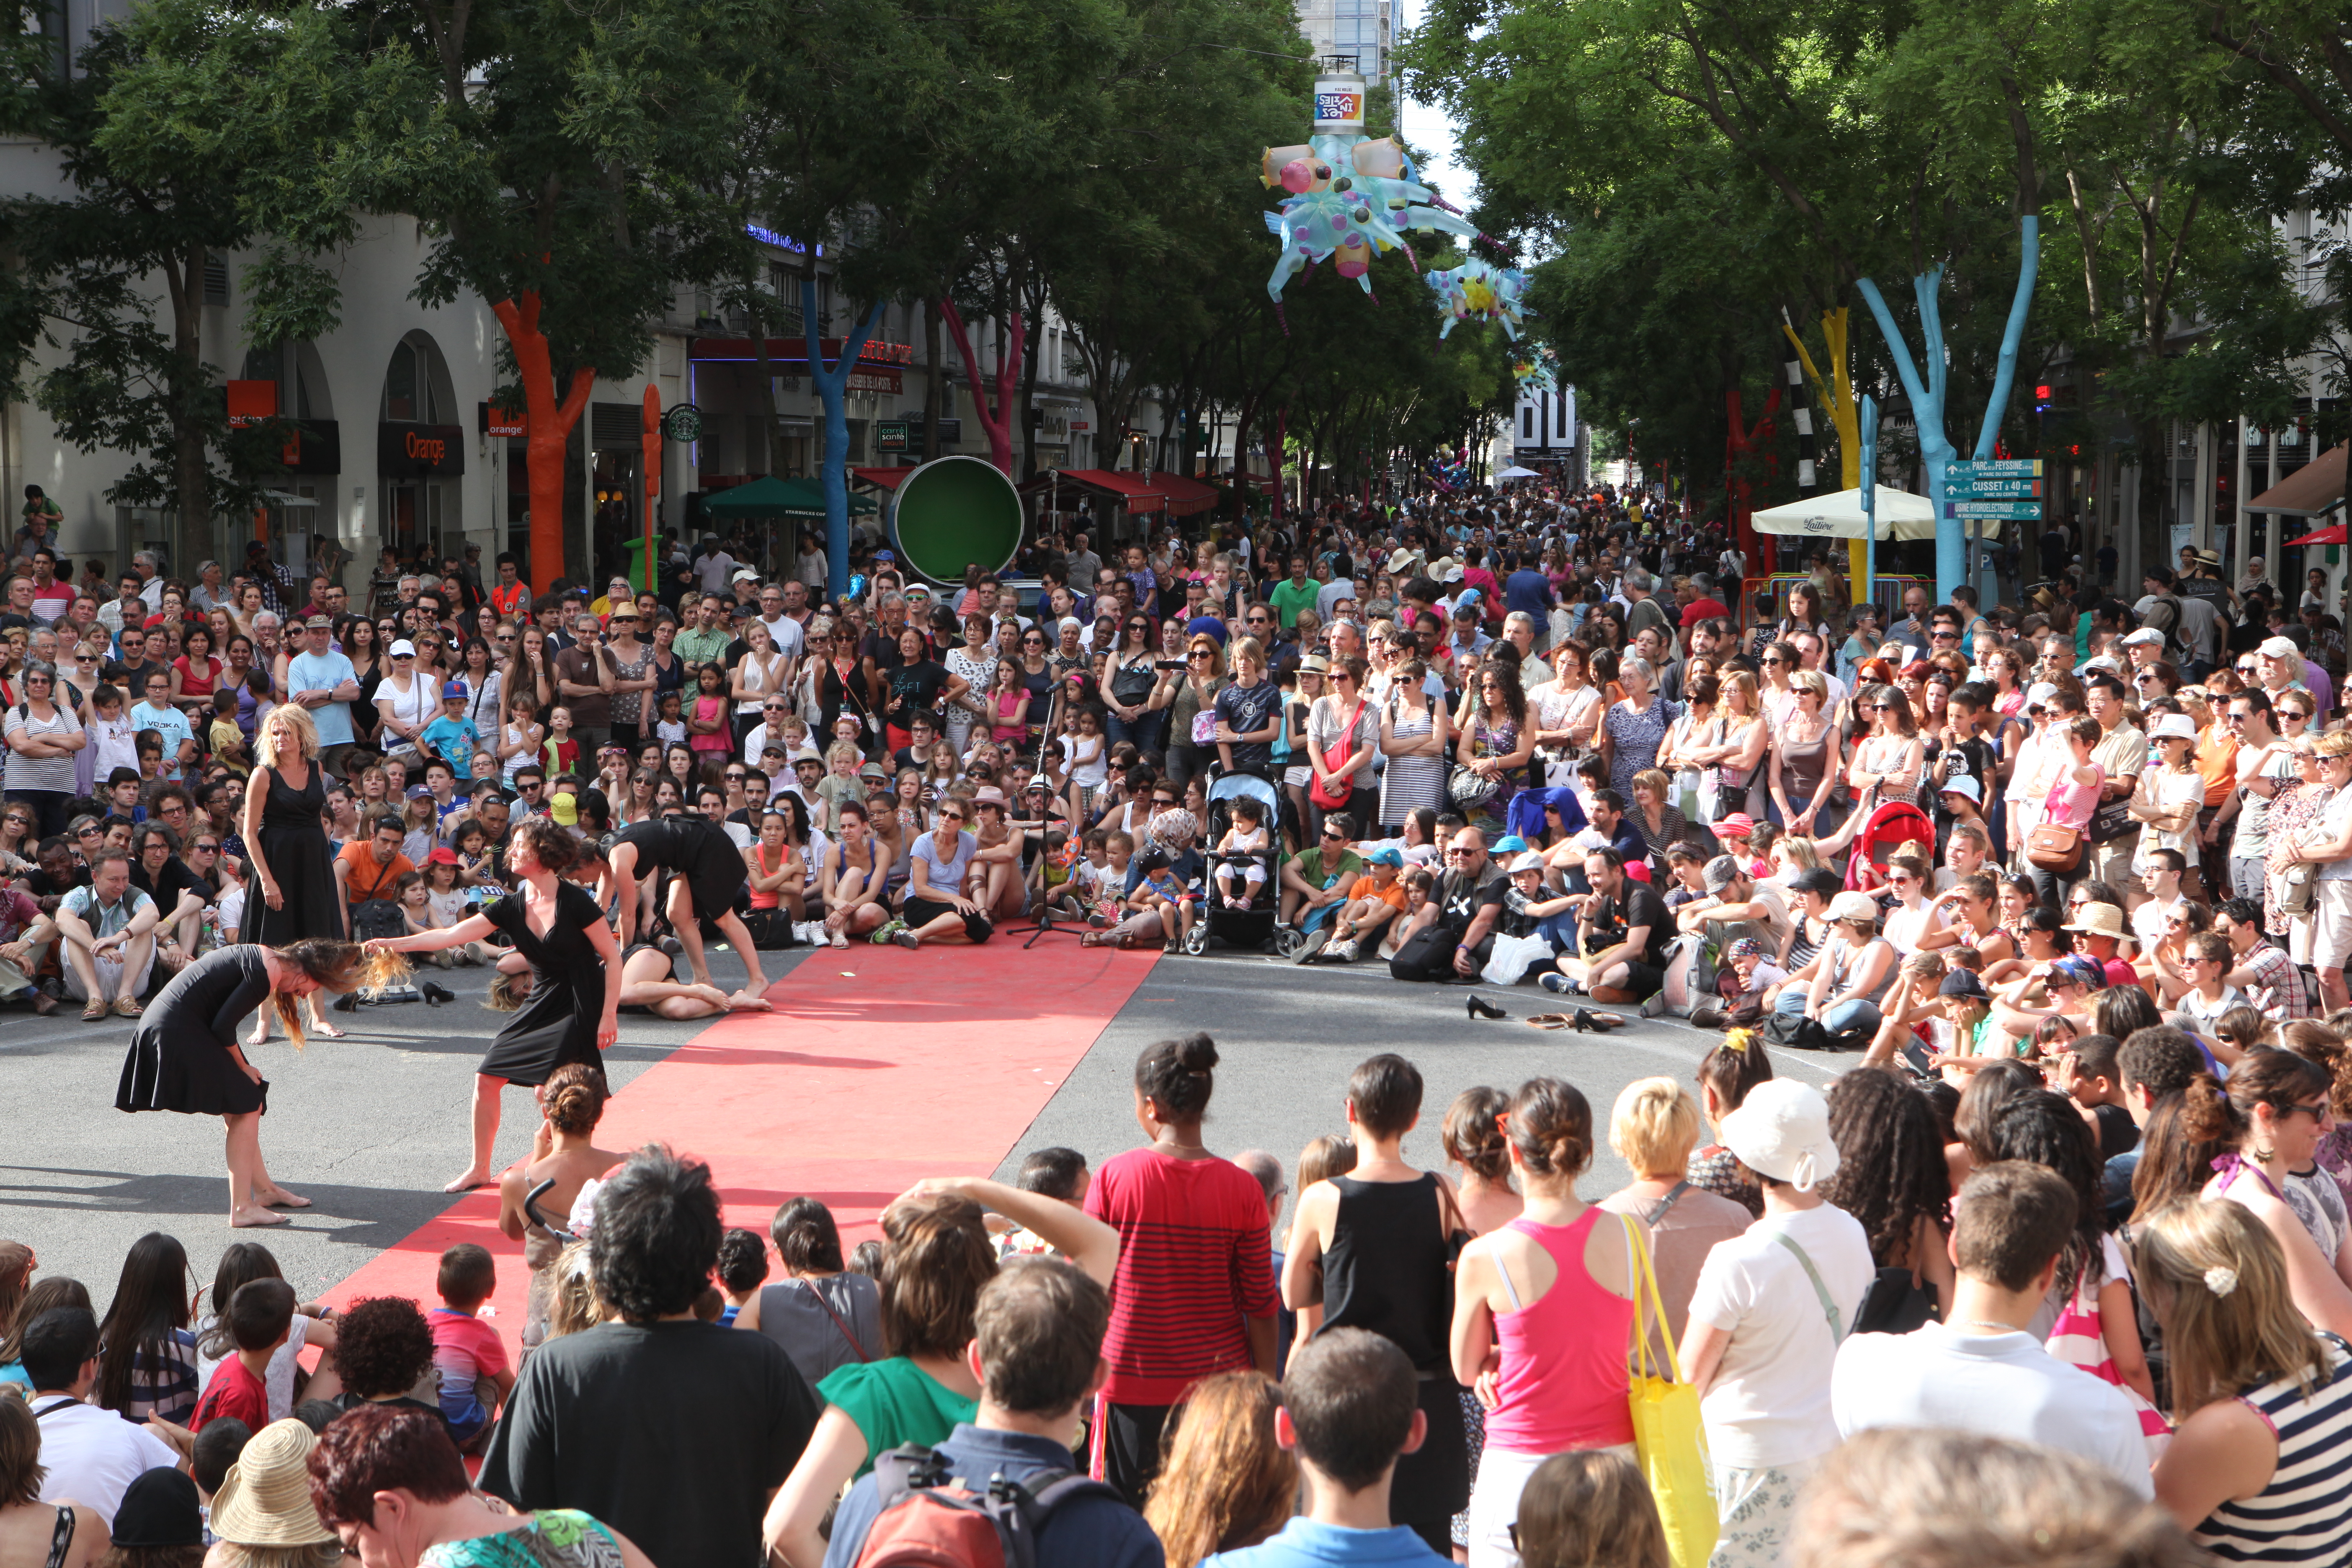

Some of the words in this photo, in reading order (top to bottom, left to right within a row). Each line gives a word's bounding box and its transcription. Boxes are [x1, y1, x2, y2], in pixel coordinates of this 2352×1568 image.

[846, 374, 866, 388] BRASSERIE
[867, 375, 872, 389] DE
[873, 376, 878, 389] LA
[879, 377, 891, 391] POSTE
[671, 411, 699, 425] STARBUCKS
[490, 426, 522, 435] orange
[674, 432, 695, 440] COFFEE
[405, 431, 444, 466] Orange
[1972, 461, 1988, 470] PARC
[1995, 461, 2022, 470] FEYSSINE
[1972, 481, 2003, 491] CUSSET
[2011, 481, 2021, 490] 40
[1955, 503, 1969, 512] USINE
[1970, 503, 2014, 513] HYDROELECTRIQUE
[1804, 518, 1834, 532] Laitière
[1981, 554, 1990, 568] P
[1245, 705, 1253, 714] 90
[147, 720, 180, 729] VODKA
